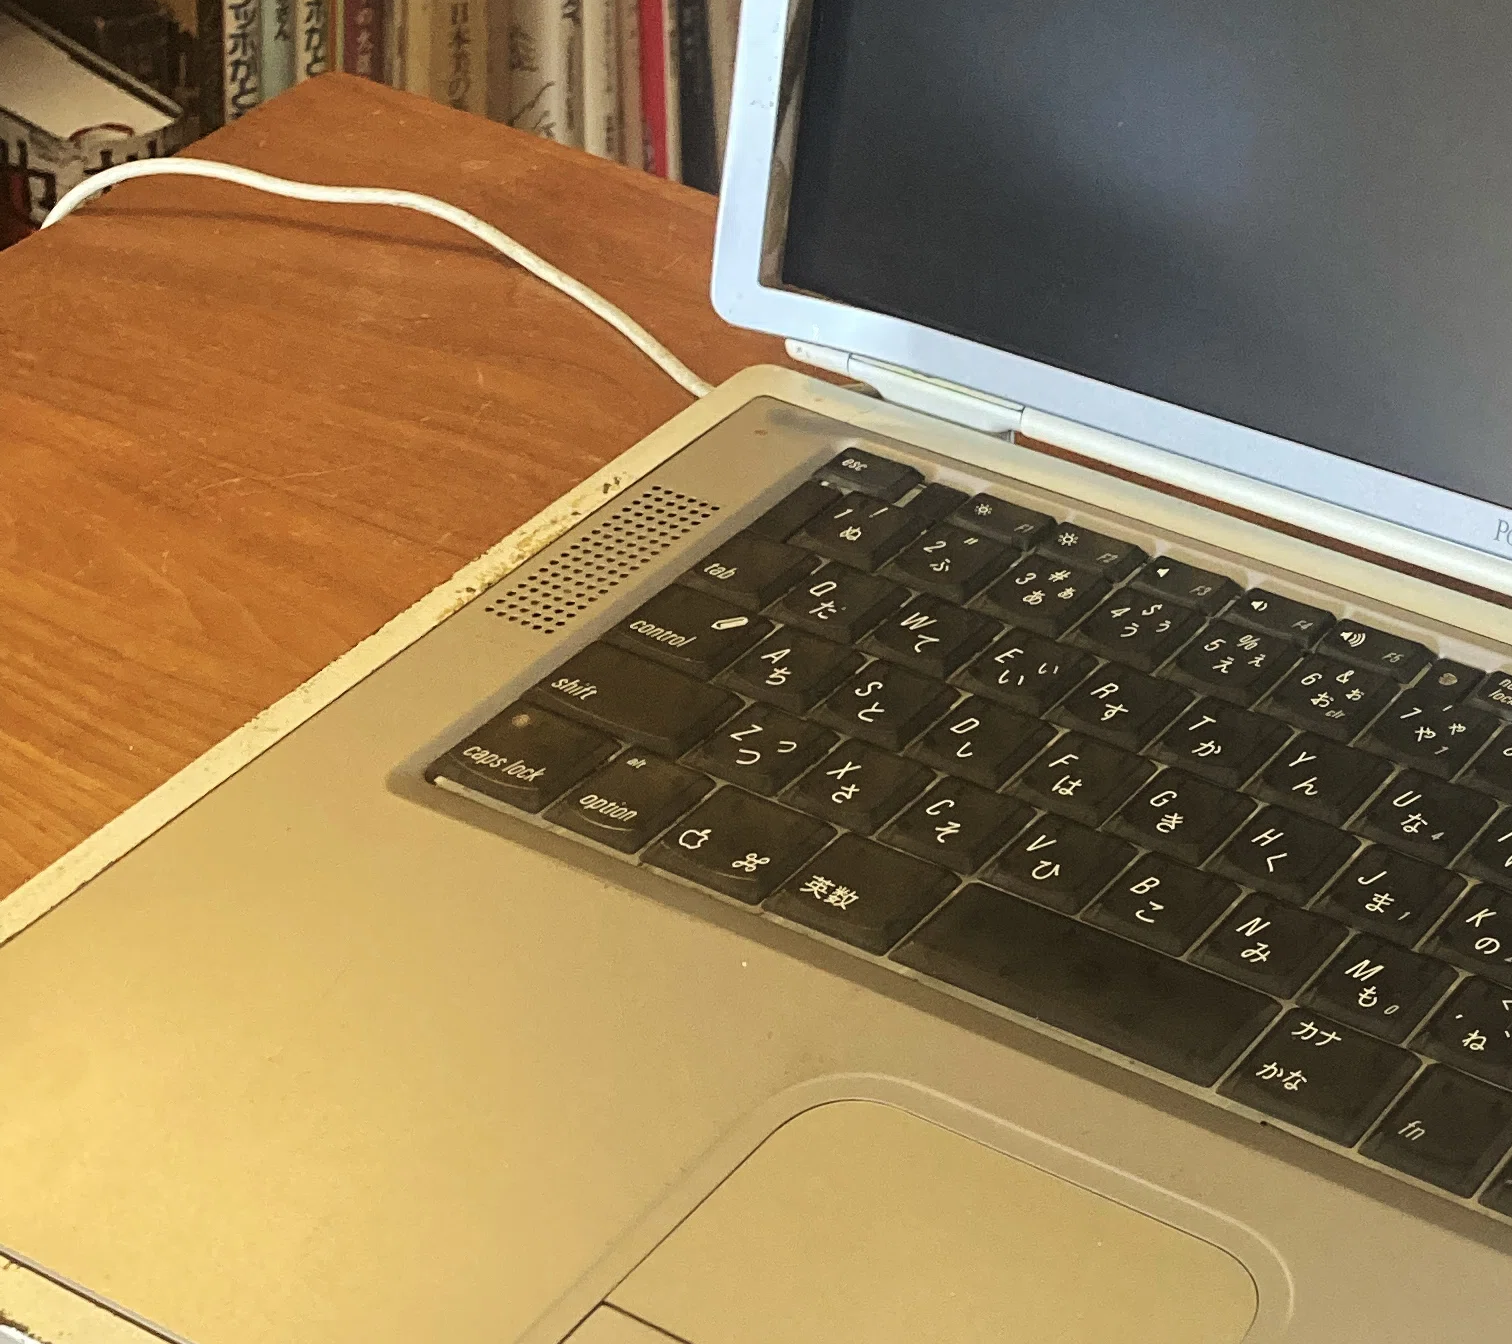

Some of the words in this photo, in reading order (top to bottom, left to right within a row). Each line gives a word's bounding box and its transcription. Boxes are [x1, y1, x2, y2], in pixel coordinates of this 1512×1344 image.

[841, 458, 868, 472] esc
[833, 508, 854, 519] 1
[839, 525, 862, 541] ぬ
[922, 540, 947, 553] 2
[703, 562, 738, 580] tab
[929, 558, 951, 572] ふ
[1014, 572, 1037, 585] 3
[1047, 569, 1071, 583] #
[1022, 589, 1046, 606] あ
[808, 600, 837, 620] た
[1110, 607, 1131, 619] 4
[900, 611, 938, 631] W
[1120, 622, 1140, 638] う
[629, 620, 698, 648] control
[1236, 634, 1261, 651] %
[914, 634, 940, 653] て
[1203, 638, 1227, 652] 5
[760, 648, 791, 665] A
[994, 647, 1024, 664] E
[1212, 656, 1235, 674] え
[765, 666, 792, 686] ち
[998, 669, 1025, 686] い
[1300, 672, 1323, 686] 6
[1335, 669, 1355, 684] &
[550, 678, 598, 701] shift
[854, 681, 884, 697] S
[1090, 682, 1119, 699] R
[1310, 691, 1335, 708] お
[857, 701, 885, 723] と
[1100, 703, 1129, 721] す
[1399, 707, 1423, 720] 7
[949, 717, 980, 734] D
[1188, 715, 1217, 731] T
[729, 723, 764, 742] Z
[1414, 726, 1437, 742] や
[735, 748, 761, 765] つ
[956, 741, 973, 758] し
[1191, 740, 1222, 757] か
[462, 745, 506, 773] caps
[501, 759, 546, 783] lock
[1048, 753, 1079, 768] F
[1288, 751, 1317, 767] Y
[825, 761, 862, 780] X
[831, 783, 861, 804] さ
[1051, 774, 1083, 796] は
[1291, 776, 1318, 796] ん
[579, 794, 638, 822] option
[925, 799, 955, 816] C
[1149, 790, 1178, 808] G
[1392, 790, 1422, 808] U
[934, 820, 961, 844] そ
[1155, 812, 1184, 834] き
[1400, 813, 1429, 834] な
[1025, 834, 1057, 852] V
[1250, 828, 1284, 847] H
[1031, 860, 1061, 880] ひ
[1266, 852, 1288, 873] く
[1129, 876, 1161, 895] B
[1357, 870, 1388, 885] J
[799, 874, 860, 911] 英数
[1135, 900, 1164, 924] こ
[1364, 892, 1395, 914] ま
[1235, 916, 1271, 937] N
[1465, 908, 1497, 928] K
[1240, 941, 1271, 963] み
[1474, 936, 1501, 955] の
[1344, 959, 1385, 982] M
[1358, 985, 1378, 1008] も
[1291, 1021, 1342, 1046] カナ
[1461, 1029, 1487, 1051] ね
[1255, 1061, 1308, 1091] かな
[1397, 1120, 1426, 1141] fn
